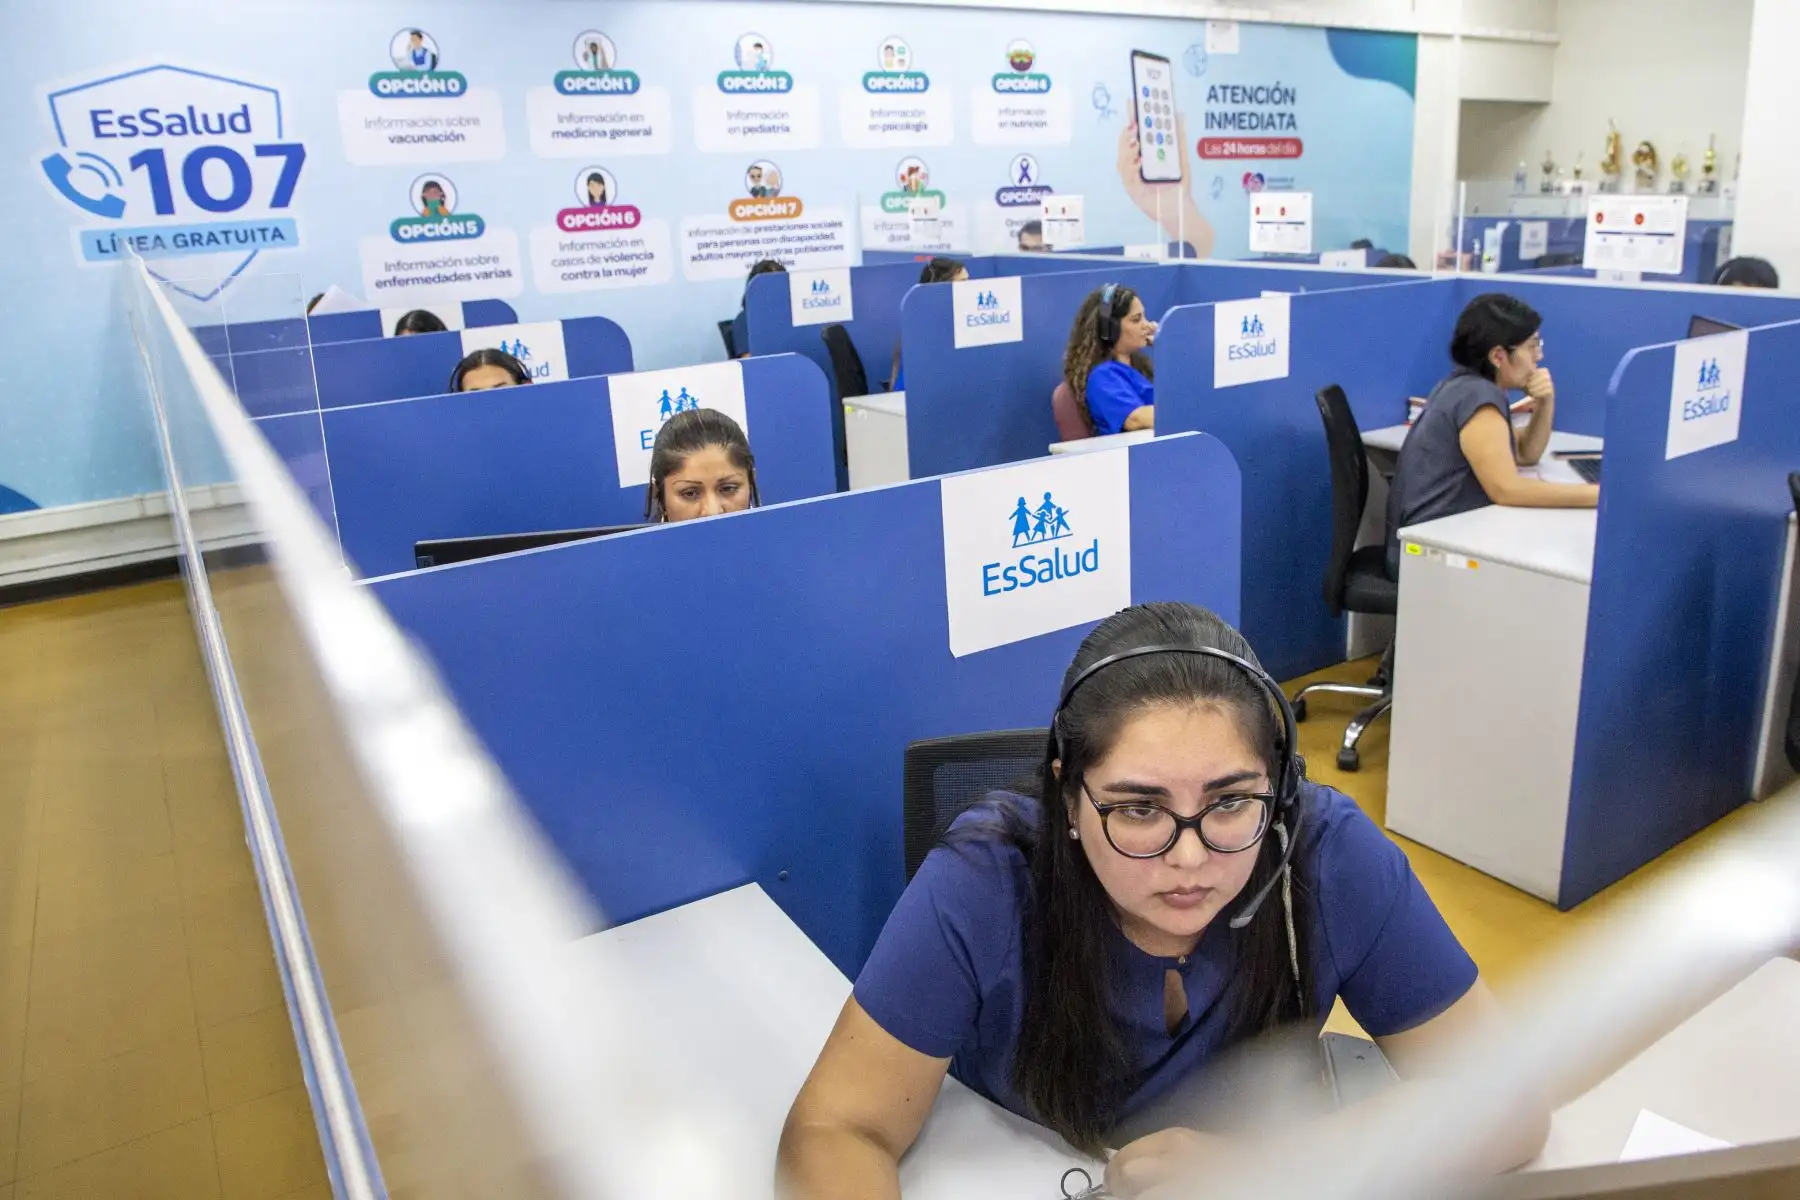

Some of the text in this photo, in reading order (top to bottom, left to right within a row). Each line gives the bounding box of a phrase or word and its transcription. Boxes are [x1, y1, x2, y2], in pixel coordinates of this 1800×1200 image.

[377, 75, 460, 94] OPCIÓN 0
[563, 73, 633, 91] OPCIÓN 1
[723, 73, 787, 90] OPCIÓN 2
[868, 74, 924, 91] OPCIÓN 3
[996, 76, 1039, 91] OPCIÓN
[1206, 80, 1296, 105] ATENCIÓN
[557, 112, 644, 124] Información en
[727, 110, 789, 121] Información
[870, 109, 925, 119] Información
[998, 107, 1046, 116] Información
[89, 104, 252, 138] EsSalud
[364, 116, 480, 129] Información sobre
[882, 121, 928, 132] psicología
[1011, 119, 1048, 128] nutrición
[1204, 111, 1297, 131] INMEDIATA
[388, 131, 465, 144] vacunación
[551, 126, 652, 140] medicina general
[728, 124, 790, 136] en pediatría
[1204, 142, 1221, 155] Las
[1222, 141, 1237, 155] 24
[1237, 141, 1266, 155] horas
[129, 143, 306, 216] 107
[735, 200, 797, 218] OPCIÓN 7
[563, 209, 635, 228] OPCIÓN 6
[172, 226, 285, 248] GRATUITA
[398, 218, 478, 239] OPCIÓN 5
[688, 220, 843, 238] Información de prestaciones sociales
[559, 238, 644, 252] Información en
[697, 240, 718, 250] para
[720, 238, 760, 249] personas
[762, 236, 777, 245] con
[551, 251, 654, 267] casos de violencia
[690, 251, 724, 262] adultos
[725, 249, 764, 261] mayores
[772, 248, 793, 257] otras
[794, 244, 844, 255] poblaciones
[384, 253, 499, 272] Información sobre
[375, 268, 512, 289] enfermedades varias
[560, 266, 648, 281] contra la mujer
[802, 295, 841, 309] EsSalud
[966, 310, 1010, 327] EsSalud
[1228, 337, 1276, 360] EsSalud
[1683, 389, 1731, 421] EsSalud
[982, 538, 1099, 597] EsSalud
